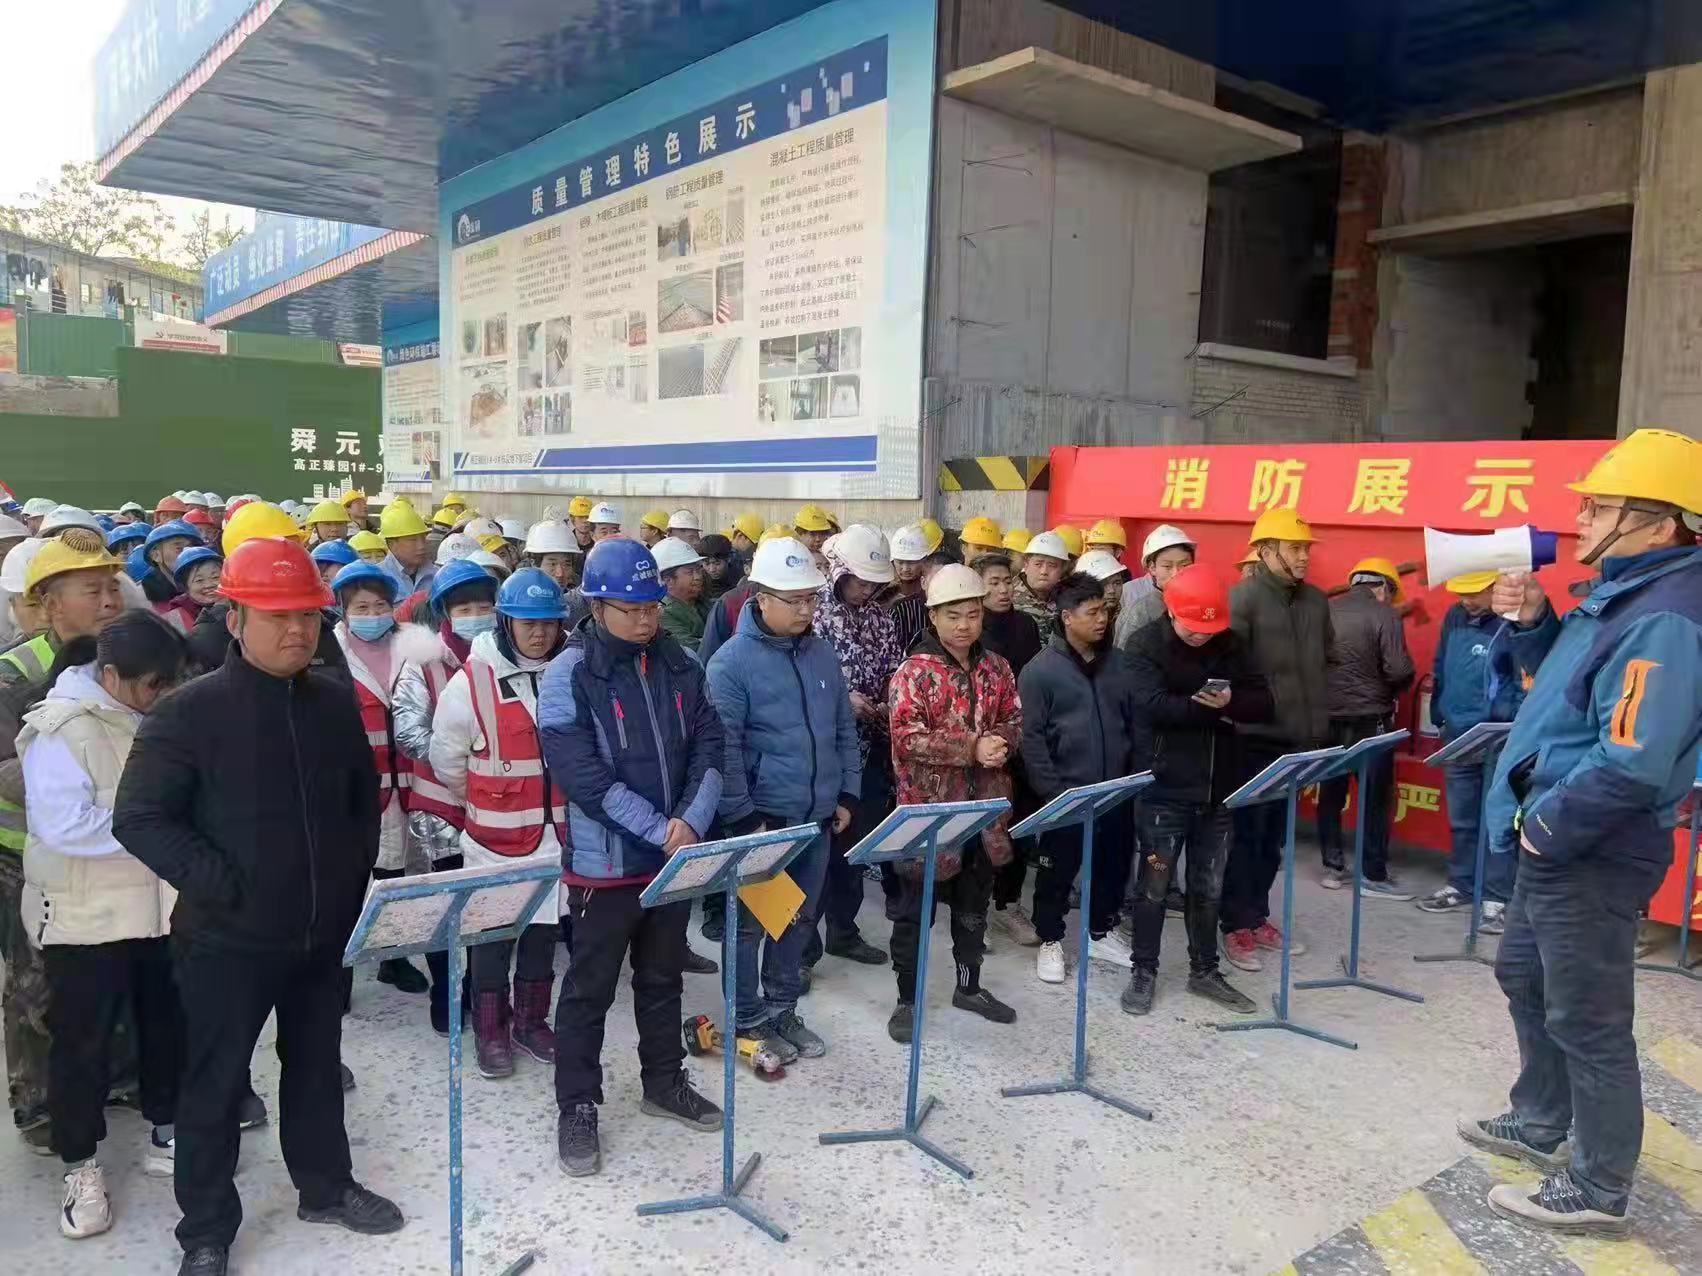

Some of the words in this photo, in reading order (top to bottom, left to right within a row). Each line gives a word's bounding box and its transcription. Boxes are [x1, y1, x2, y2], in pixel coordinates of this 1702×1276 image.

[531, 102, 757, 216] 质量管理特色展示
[769, 128, 855, 167] 混凝土工程质量管理
[1160, 457, 1535, 518] 消防展示
